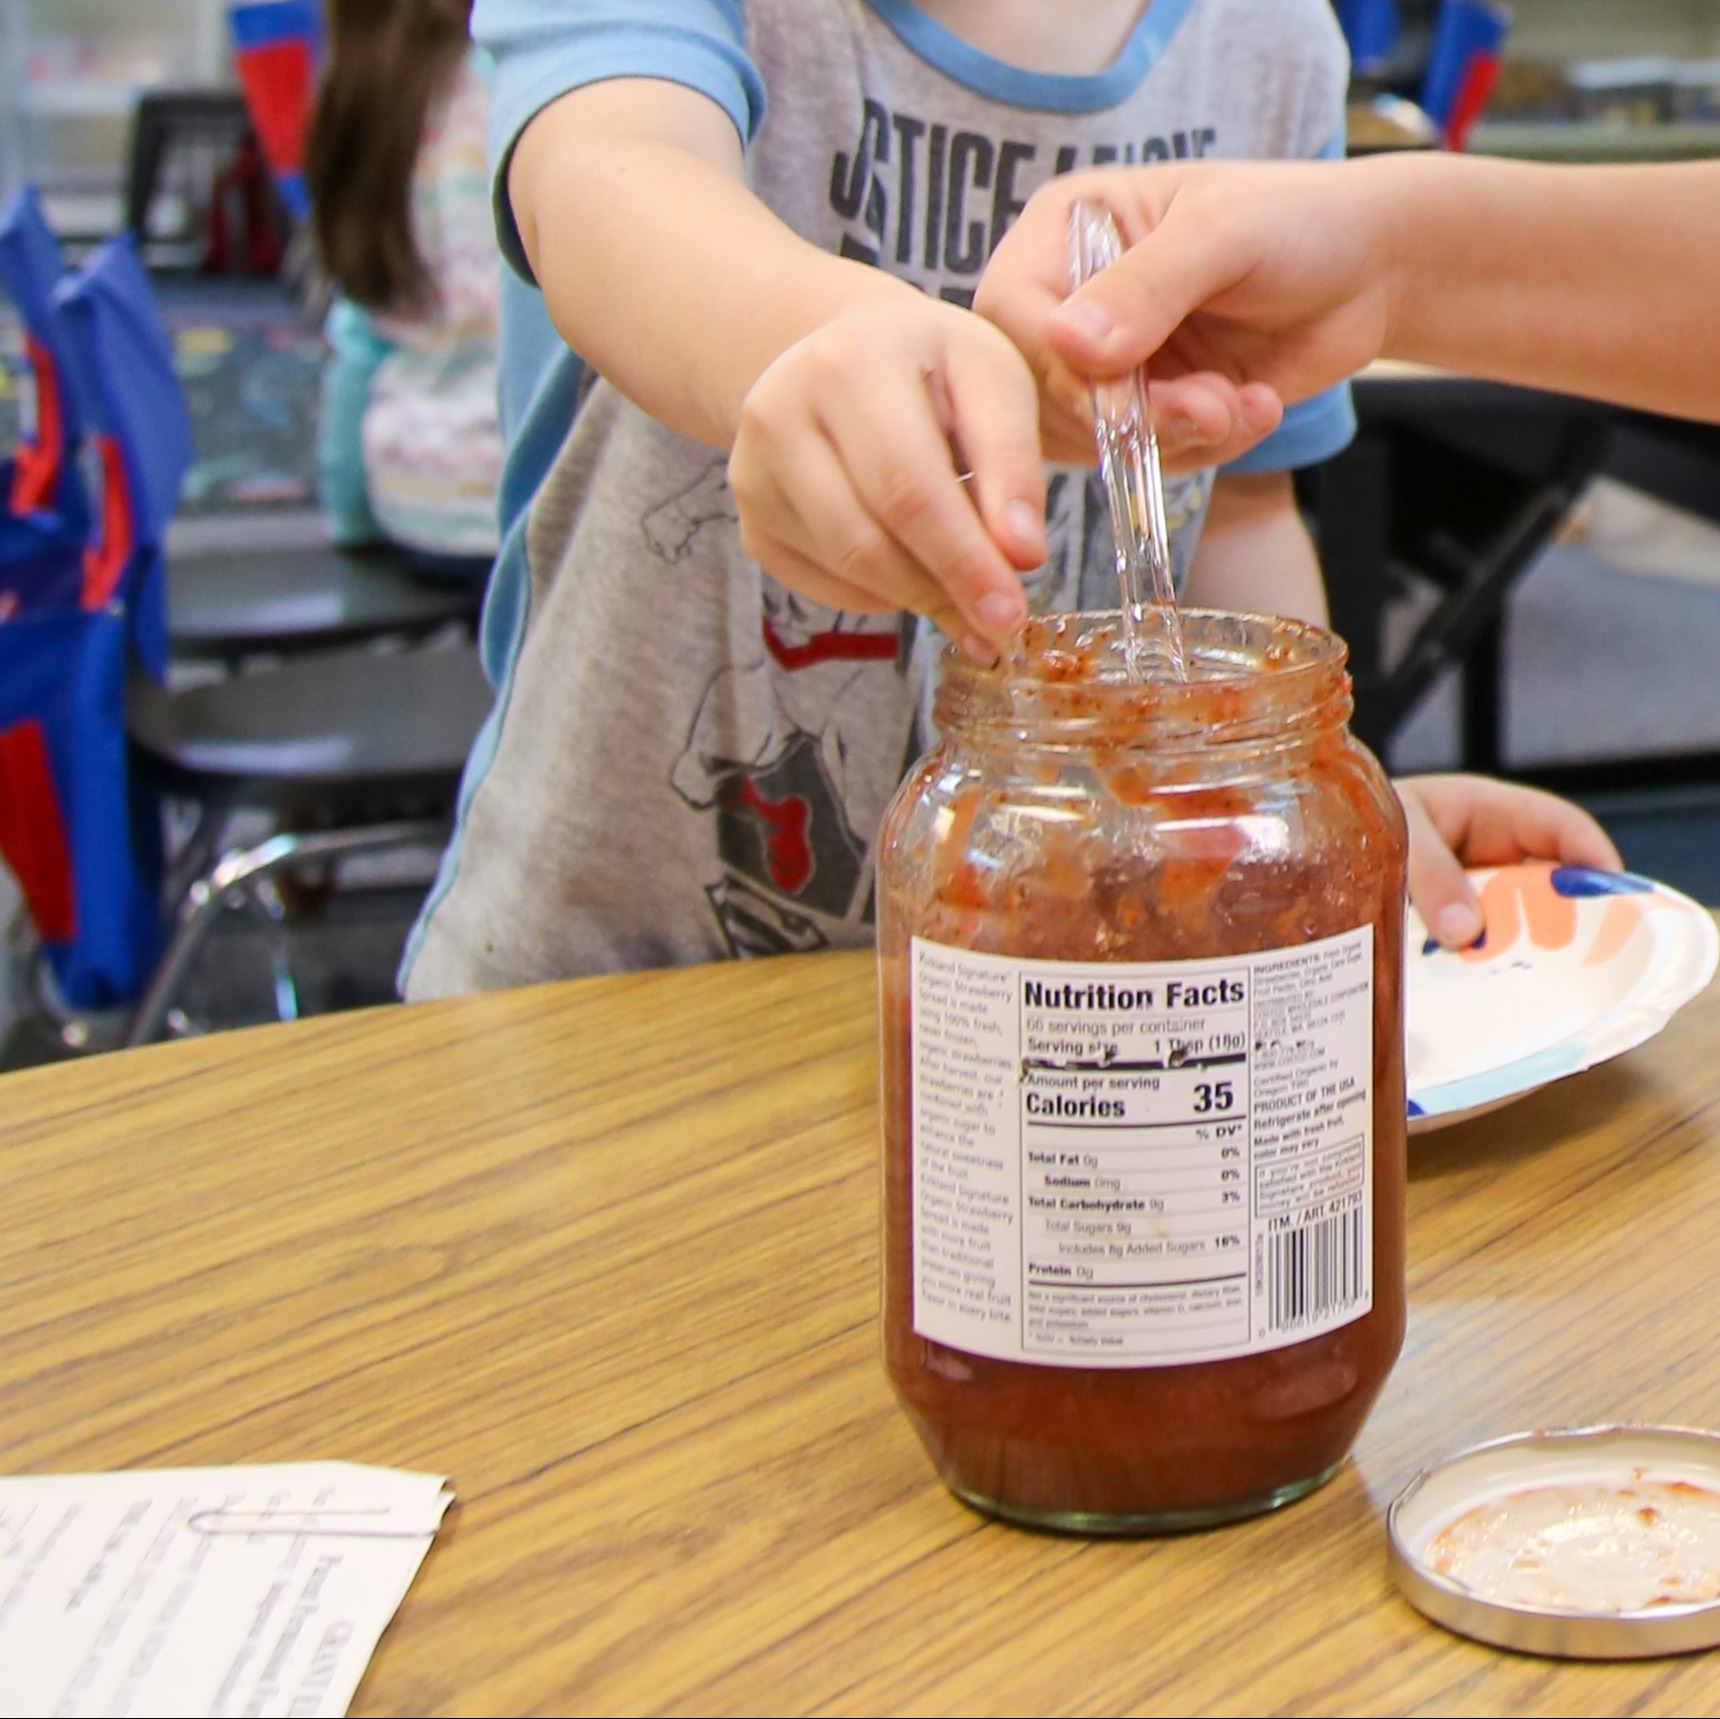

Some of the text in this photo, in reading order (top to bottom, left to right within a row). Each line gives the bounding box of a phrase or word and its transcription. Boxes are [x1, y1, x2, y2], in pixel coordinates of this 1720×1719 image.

[1025, 978, 1244, 1010] Nutrition Facts
[1049, 1022, 1107, 1036] servings
[1112, 1022, 1135, 1035] per
[1140, 1018, 1206, 1034] container
[1028, 1038, 1083, 1055] Serving
[1155, 1040, 1160, 1053] 1
[1027, 1073, 1160, 1091] Amount per serving
[1026, 1082, 1235, 1118] Calories 35
[1253, 1075, 1355, 1114] PRODUCT OF THE USA
[1253, 1088, 1366, 1133] Refrigerate after opening
[1253, 1132, 1279, 1147] Made
[1304, 1120, 1325, 1136] fresh
[1029, 1147, 1241, 1168] Total Fat 0g 0%
[1045, 1175, 1091, 1188] Sodium
[1221, 1169, 1241, 1181] 0%
[1029, 1196, 1056, 1209] Total
[1060, 1197, 1146, 1213] Carbohydrate
[1329, 1188, 1362, 1215] 421793
[1046, 1219, 1070, 1231] Total
[1074, 1219, 1113, 1236] Sugars
[1059, 1241, 1105, 1255] Includes
[1126, 1241, 1163, 1255] Added
[1166, 1239, 1206, 1255] Sugars
[1029, 1261, 1094, 1279] Protein 0g
